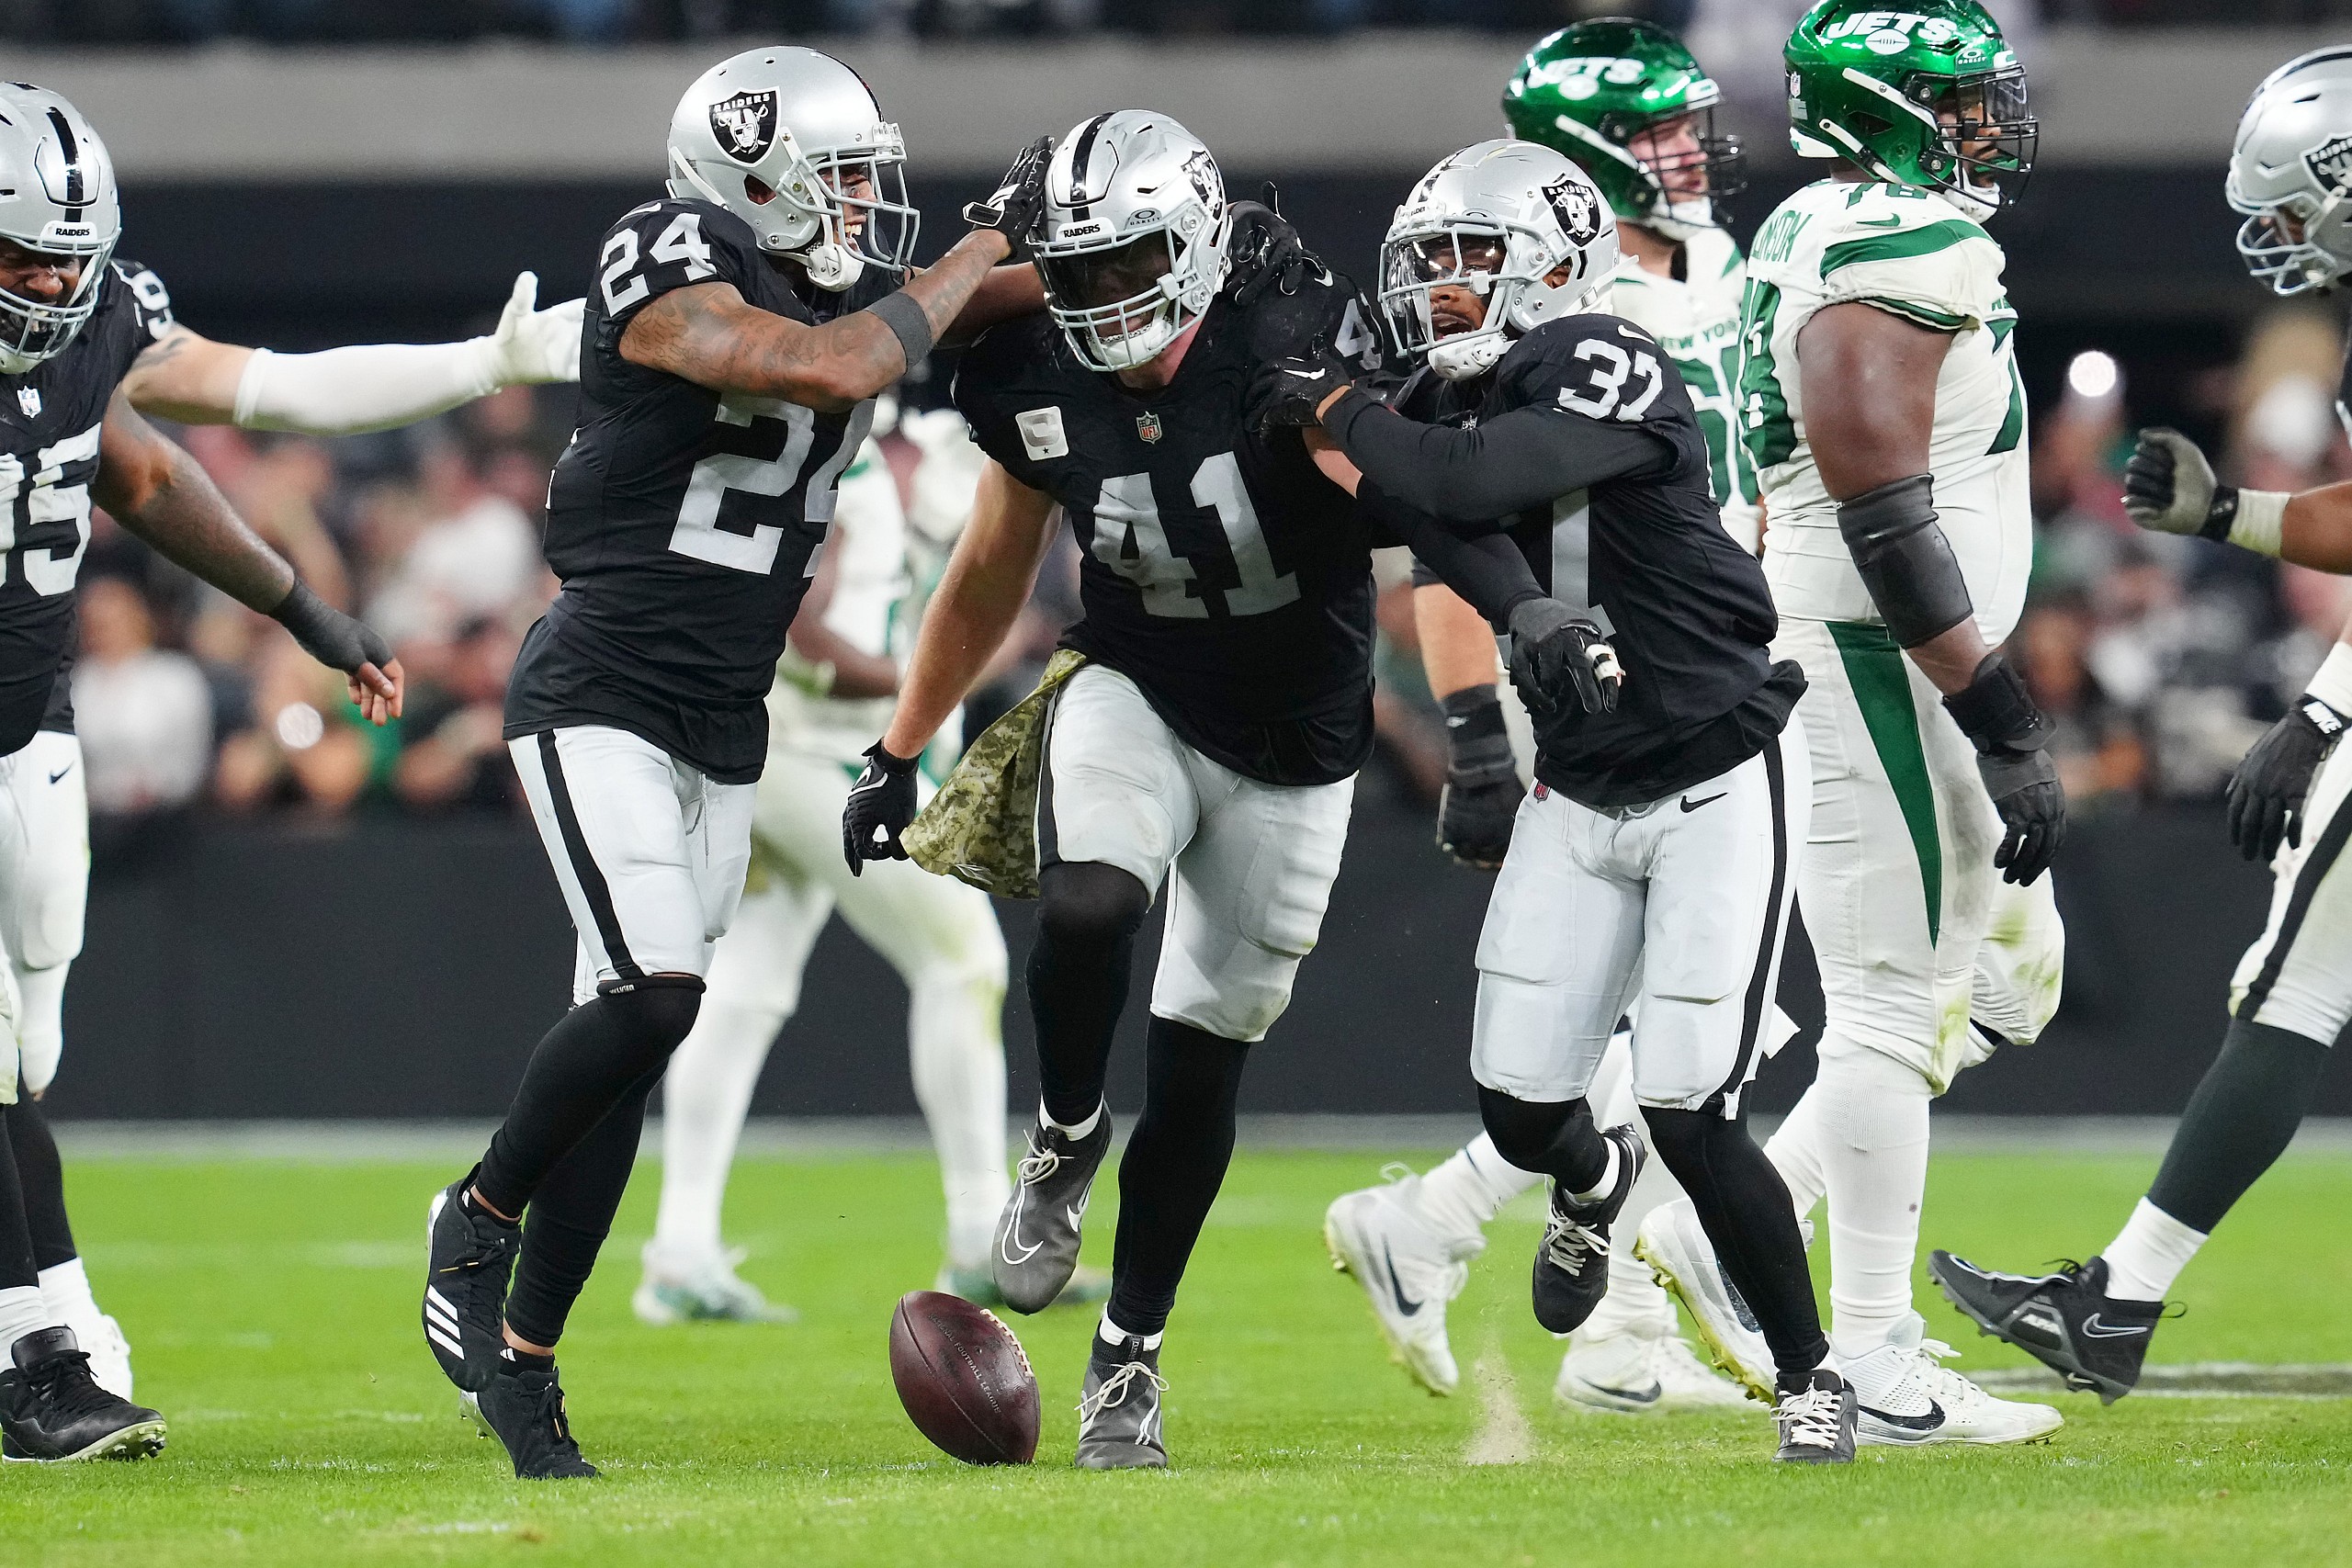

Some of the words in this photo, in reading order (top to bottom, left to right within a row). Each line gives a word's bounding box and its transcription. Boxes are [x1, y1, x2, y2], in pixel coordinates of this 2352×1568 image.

[1827, 12, 1958, 42] JETS
[1527, 57, 1645, 88] JETS
[713, 93, 771, 113] RAIDERS
[55, 228, 90, 237] RAIDERS
[1063, 224, 1101, 238] RAIDERS
[599, 212, 717, 317] 24
[1557, 338, 1663, 423] 37
[1140, 426, 1159, 439] NFL
[1091, 451, 1302, 619] 41
[954, 1341, 982, 1380] FOOTBALL
[979, 1382, 1002, 1415] LEAGUE
